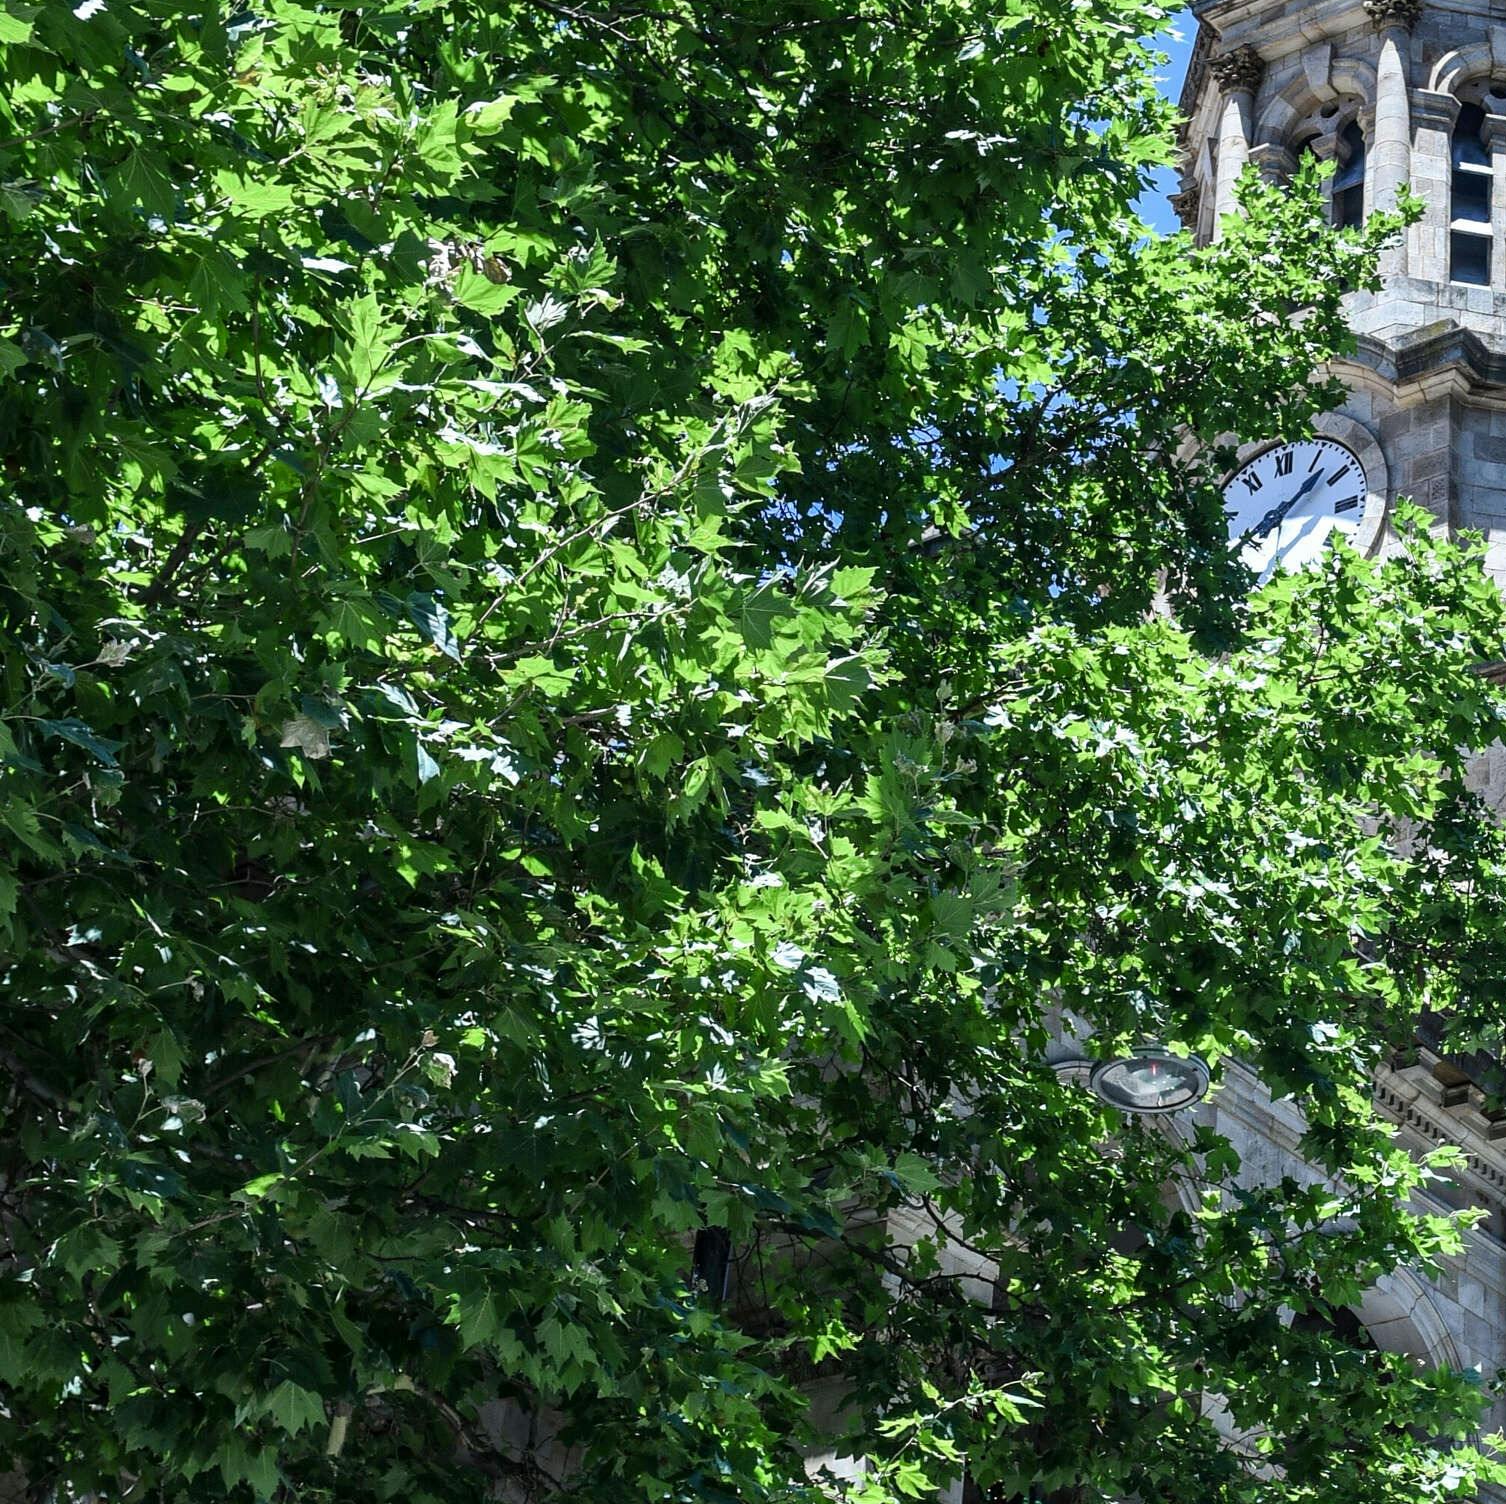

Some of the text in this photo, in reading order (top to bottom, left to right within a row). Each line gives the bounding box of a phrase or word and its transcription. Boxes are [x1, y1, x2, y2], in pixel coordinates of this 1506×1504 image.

[1274, 450, 1294, 478] XII
[1326, 464, 1350, 487] II
[1242, 470, 1263, 496] XI
